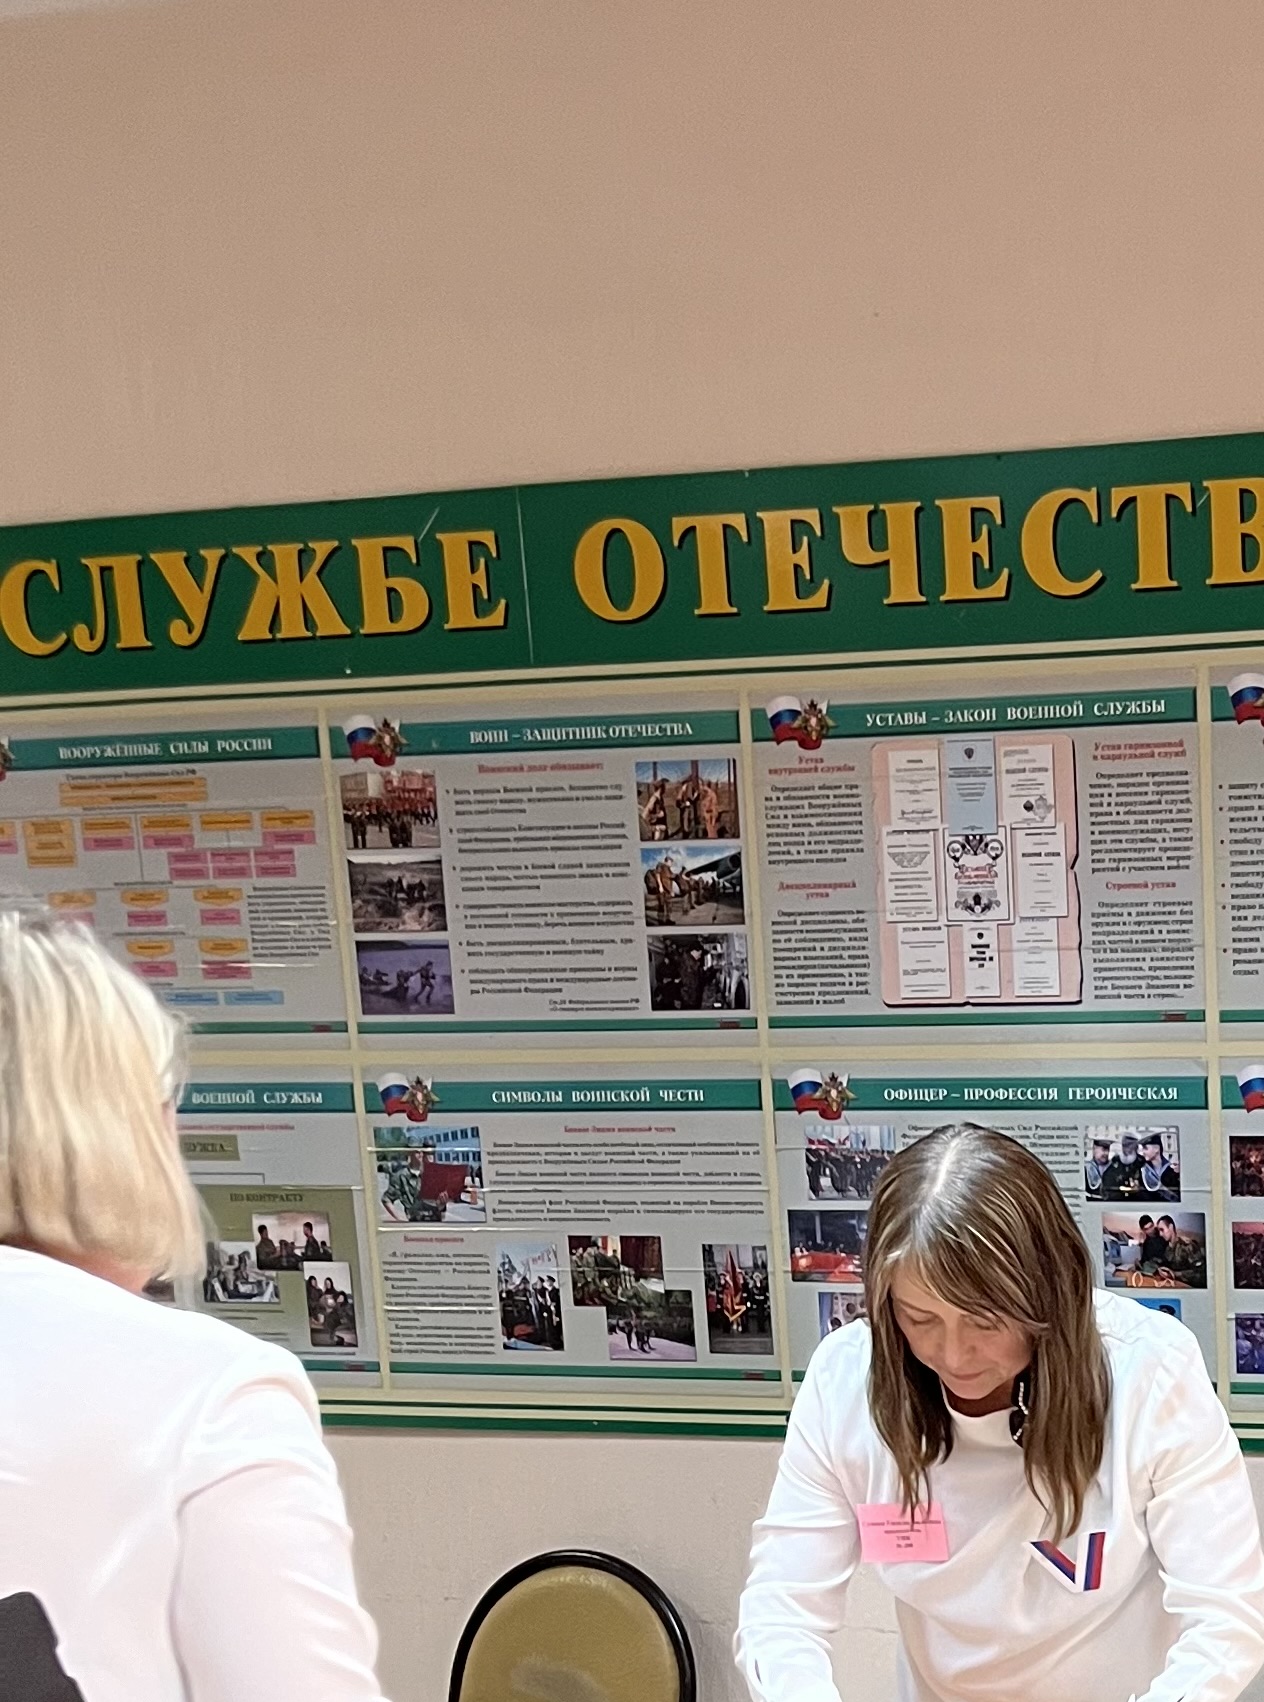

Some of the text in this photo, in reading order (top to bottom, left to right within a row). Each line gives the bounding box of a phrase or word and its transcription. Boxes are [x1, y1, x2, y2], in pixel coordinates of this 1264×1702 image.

[0, 529, 508, 657] СЛУЖБЕ
[866, 699, 1166, 727] УСТАВЫ ЗАКОН ВОЕННОЙ СЛУЖБЫ
[469, 720, 693, 744] ВОИН ЗАЩИТНИК ОТЕЧЕСТВА
[492, 1087, 704, 1103] СИМВОЛЫ ВОИНСКОЙ ЧЕСТИ
[884, 1087, 1178, 1103] ОФИЦЕР ПРОФЕССИЯ ГЕРОИЧЕСКАЯ
